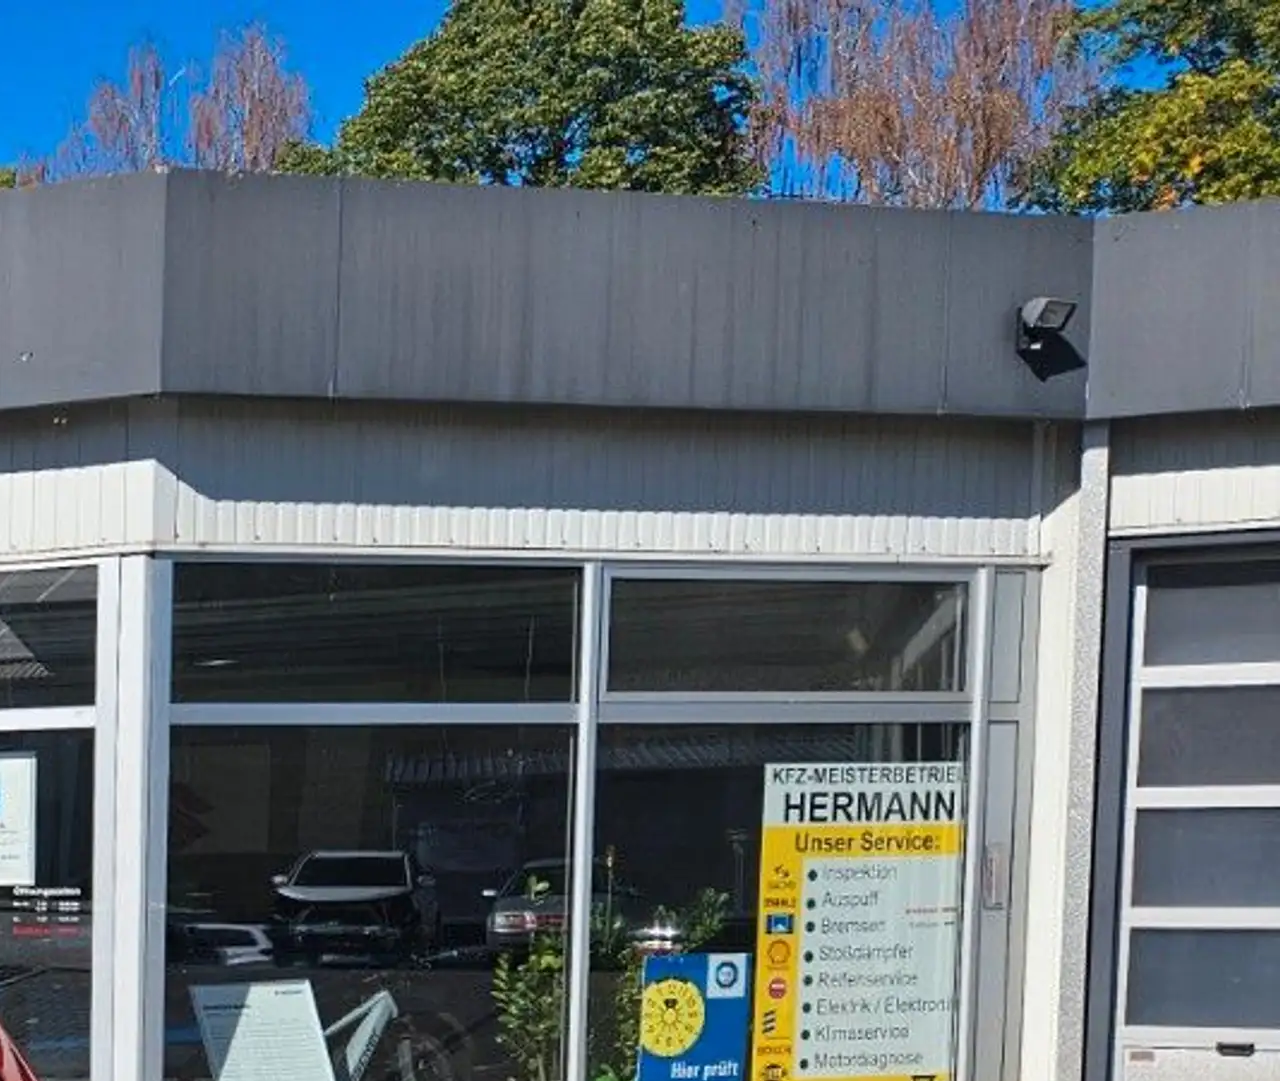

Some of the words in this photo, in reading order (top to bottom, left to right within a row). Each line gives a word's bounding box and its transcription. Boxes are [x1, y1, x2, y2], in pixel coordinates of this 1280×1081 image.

[783, 789, 955, 823] HERMANN
[794, 831, 855, 853] Unser
[860, 828, 940, 852] Service:
[822, 864, 898, 882] Inspektion
[821, 891, 879, 908] Auspuff
[820, 919, 887, 935] Bremsen
[817, 971, 919, 988] Reifenservice
[883, 995, 953, 1014] Elektroni
[814, 1026, 910, 1042] Klimaservice
[670, 1060, 701, 1079] Hier
[703, 1059, 739, 1081] prüft
[813, 1053, 925, 1070] Motordiagnose
